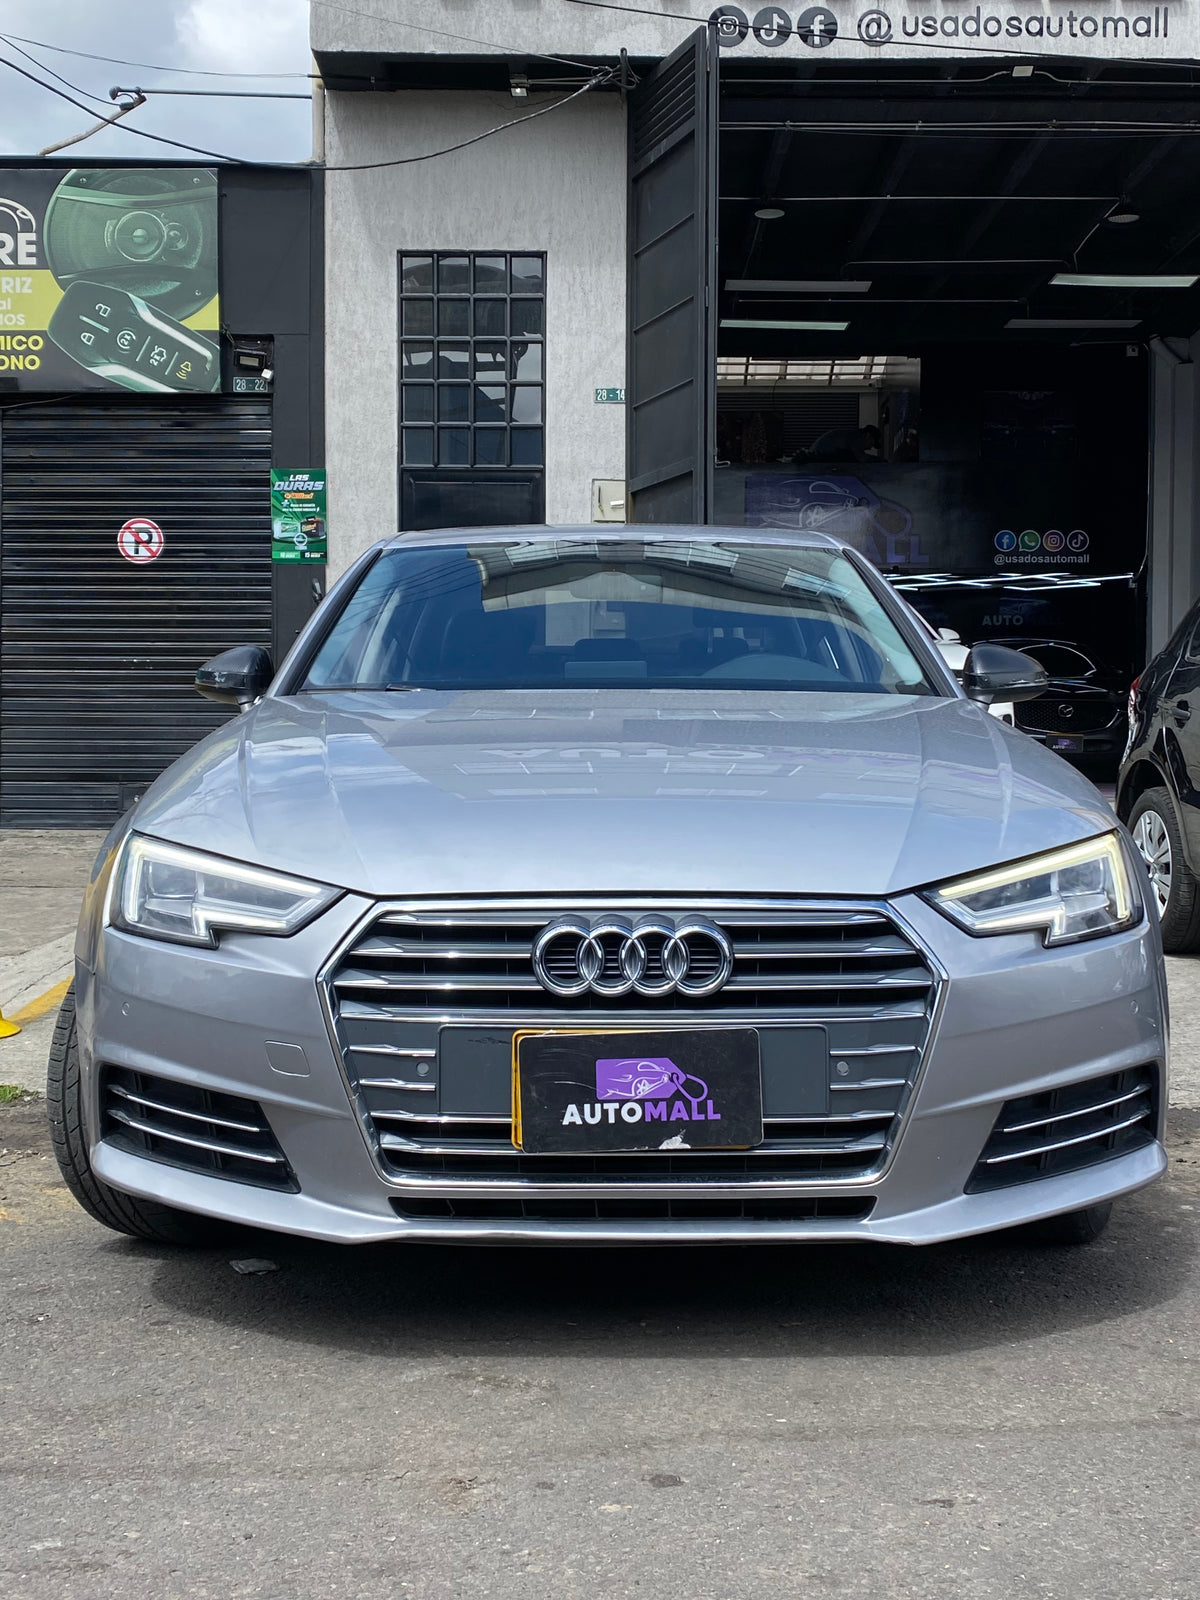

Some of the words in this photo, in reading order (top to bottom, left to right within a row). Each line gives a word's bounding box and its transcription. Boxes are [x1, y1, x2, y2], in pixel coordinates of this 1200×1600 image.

[1, 276, 33, 294] RIZ
[0, 335, 44, 351] ICO
[597, 389, 607, 401] 28
[273, 481, 325, 491] DURAS
[994, 553, 1090, 566] @usadosautomall
[561, 1099, 721, 1126] AUTOMALL
